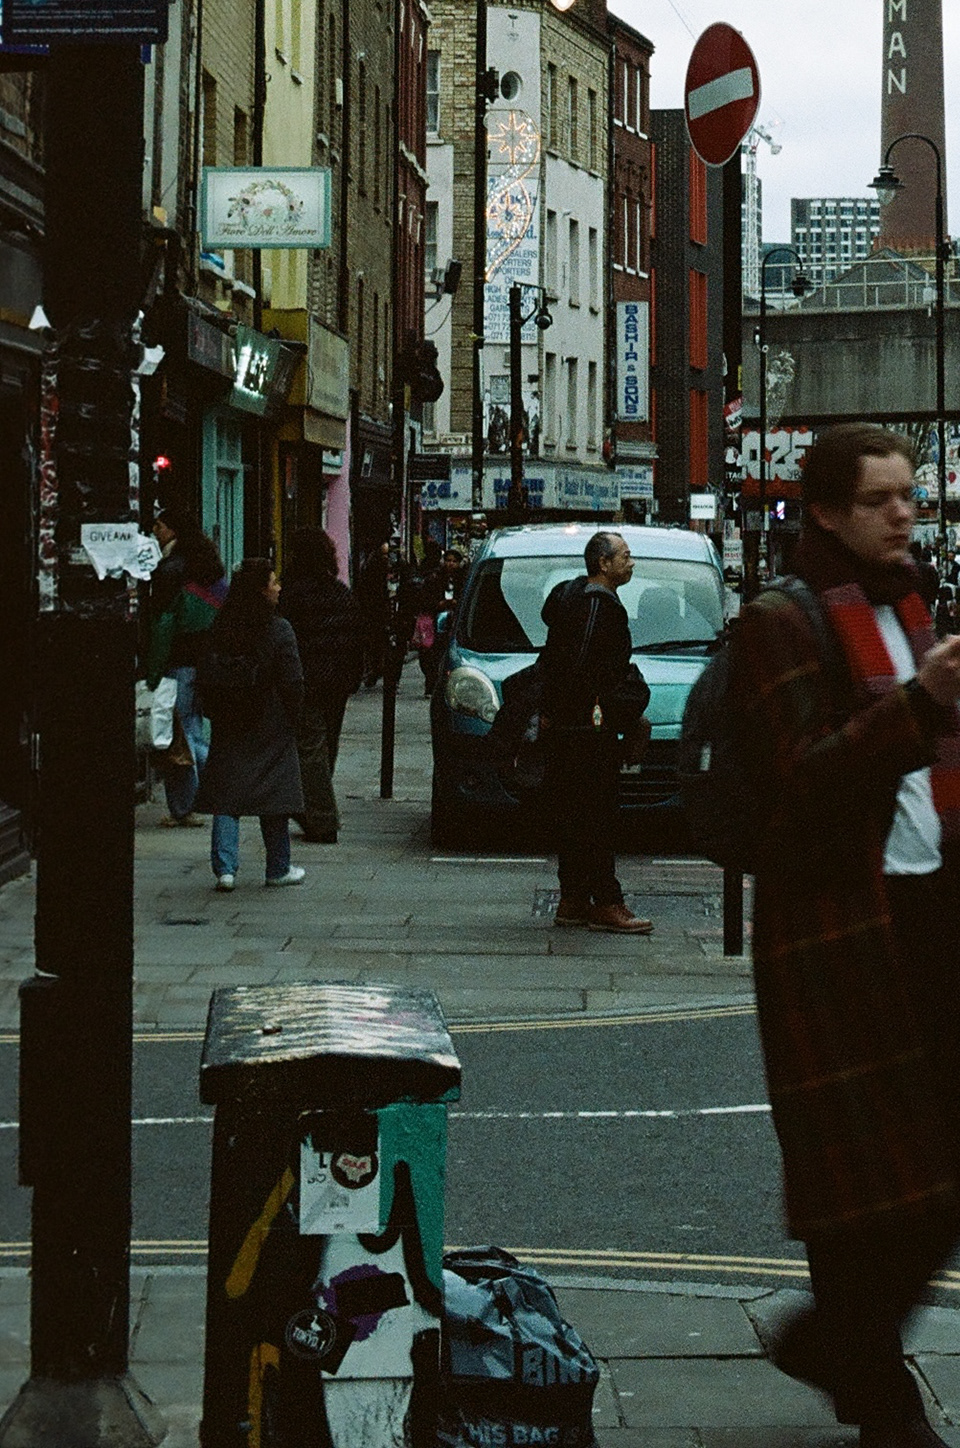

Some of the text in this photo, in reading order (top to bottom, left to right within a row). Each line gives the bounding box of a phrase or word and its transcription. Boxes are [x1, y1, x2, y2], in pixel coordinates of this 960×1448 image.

[624, 304, 638, 361] BASHIR
[624, 375, 638, 415] SONS
[512, 1423, 560, 1445] BAG
